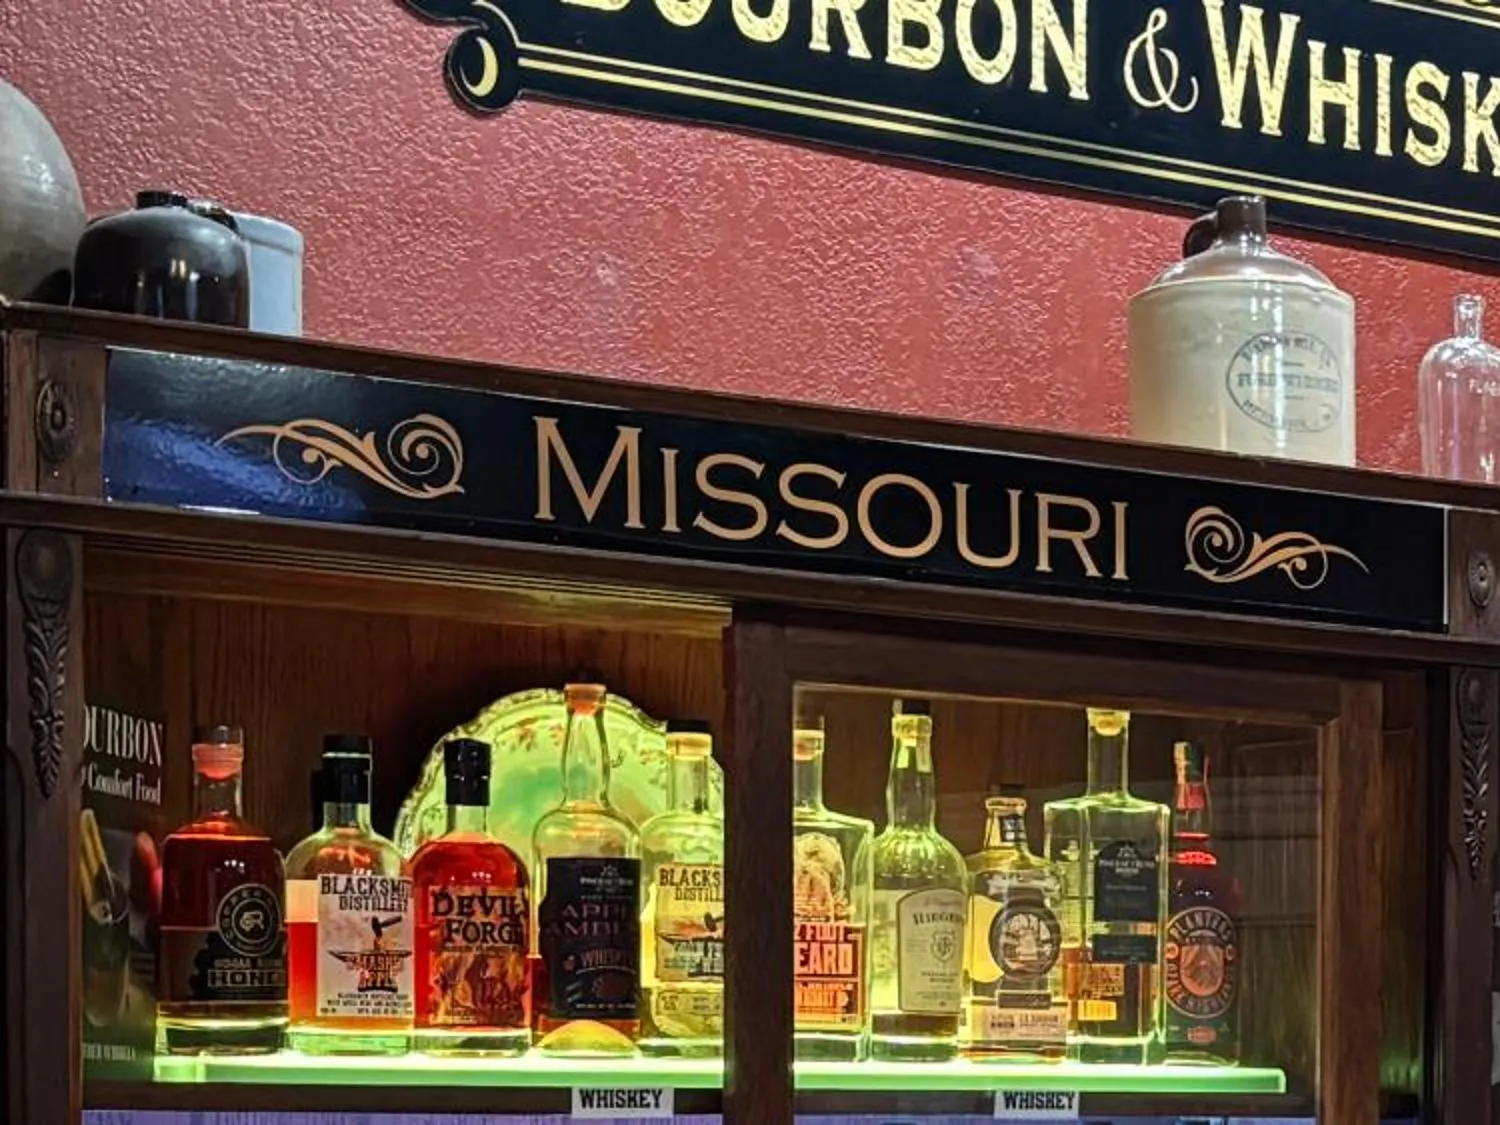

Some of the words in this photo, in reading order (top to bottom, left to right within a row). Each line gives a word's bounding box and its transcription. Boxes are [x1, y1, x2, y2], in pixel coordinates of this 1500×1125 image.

[560, 0, 1090, 100] RBON
[1123, 8, 1198, 113] &
[533, 414, 1130, 583] MISSOURI
[579, 1087, 663, 1109] WHISKEY
[1003, 1090, 1077, 1111] WHISKEY
